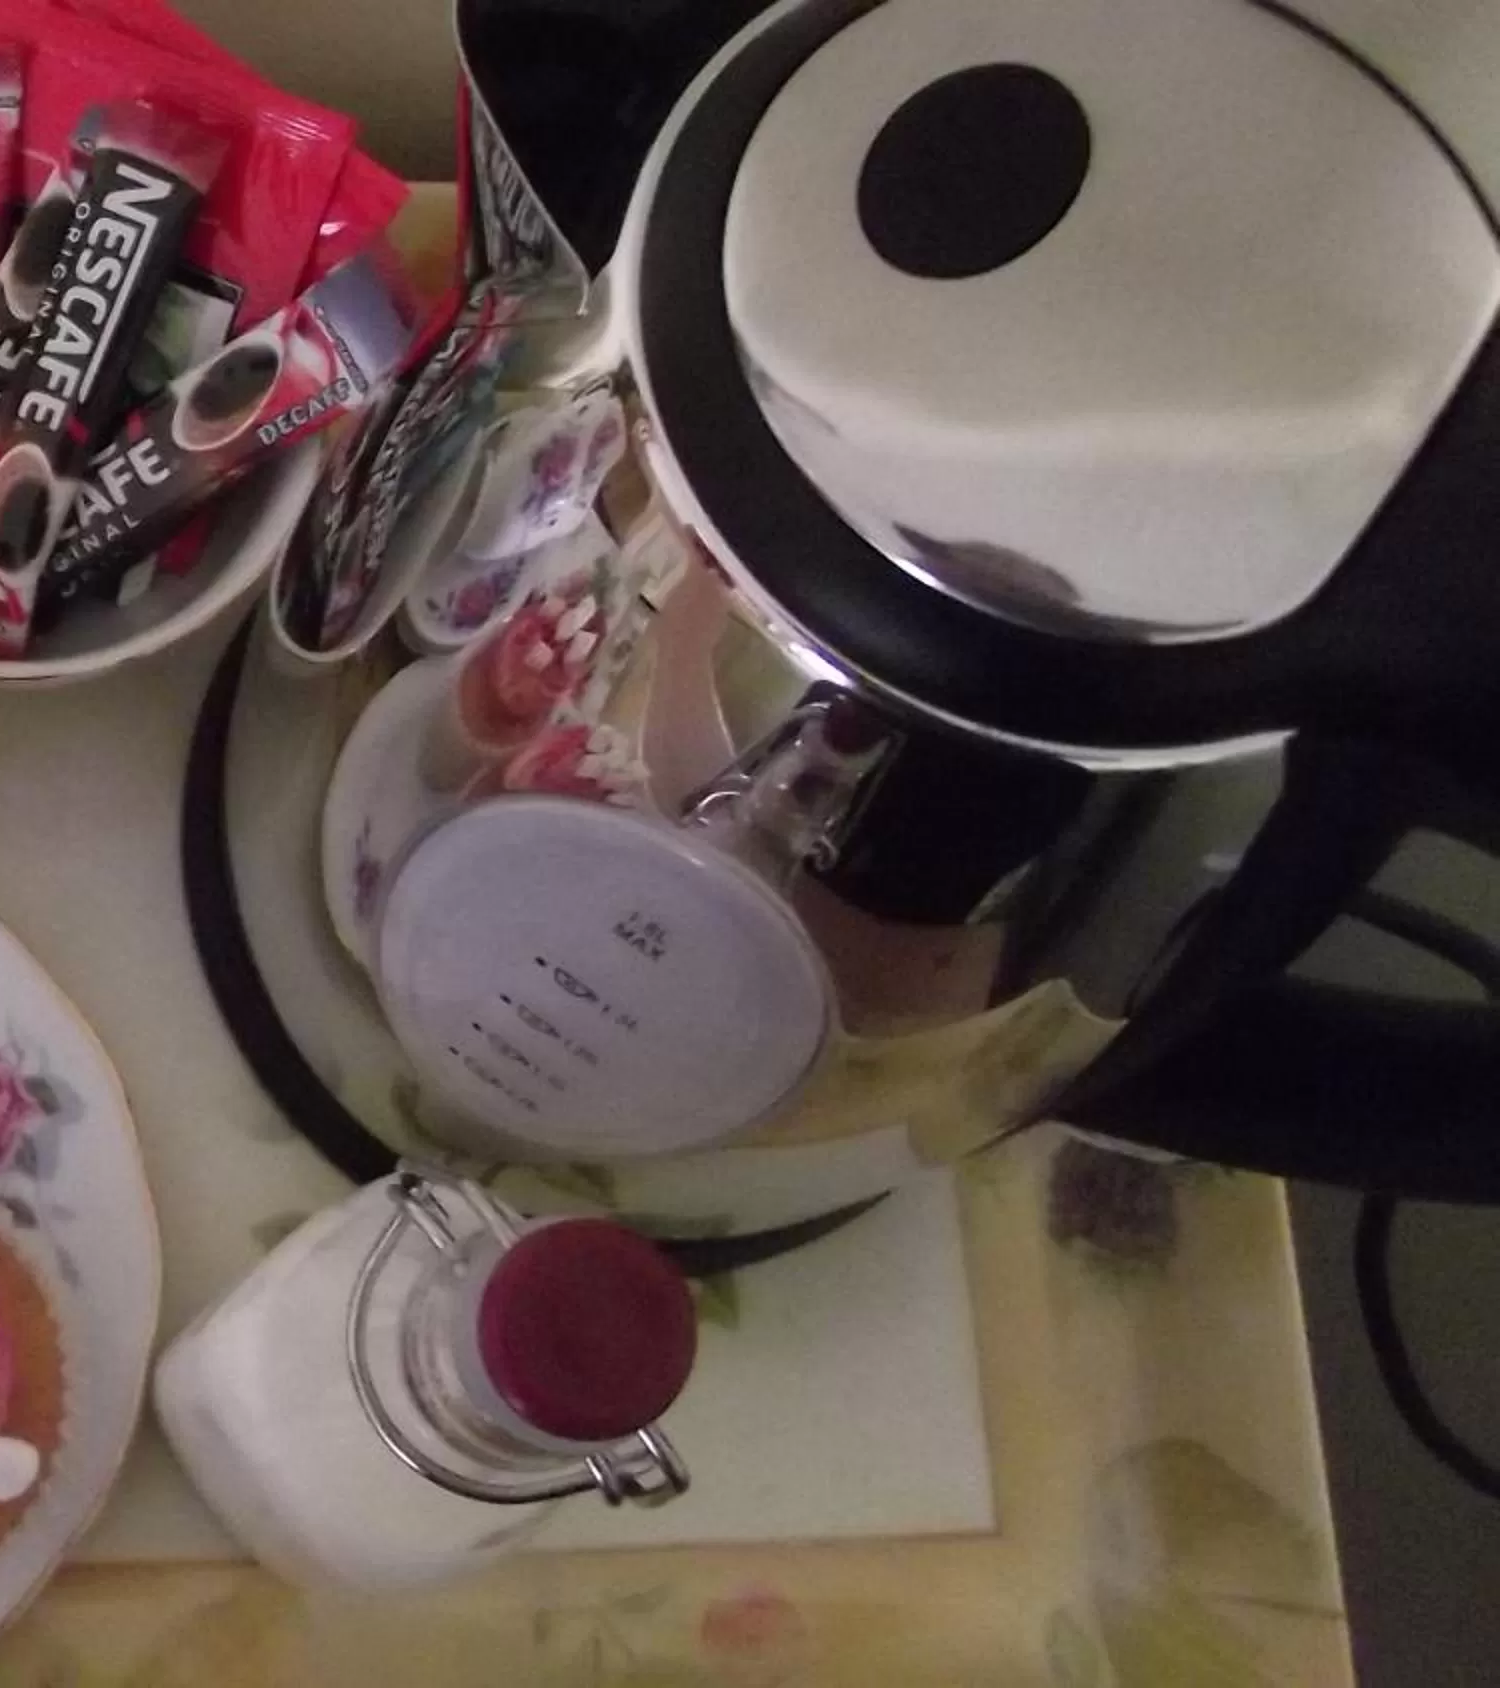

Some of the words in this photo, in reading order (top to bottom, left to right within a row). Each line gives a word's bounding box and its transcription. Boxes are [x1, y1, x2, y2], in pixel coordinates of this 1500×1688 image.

[22, 200, 91, 357] ORIGINAL
[52, 514, 142, 573] GINAL
[612, 921, 667, 963] MAX
